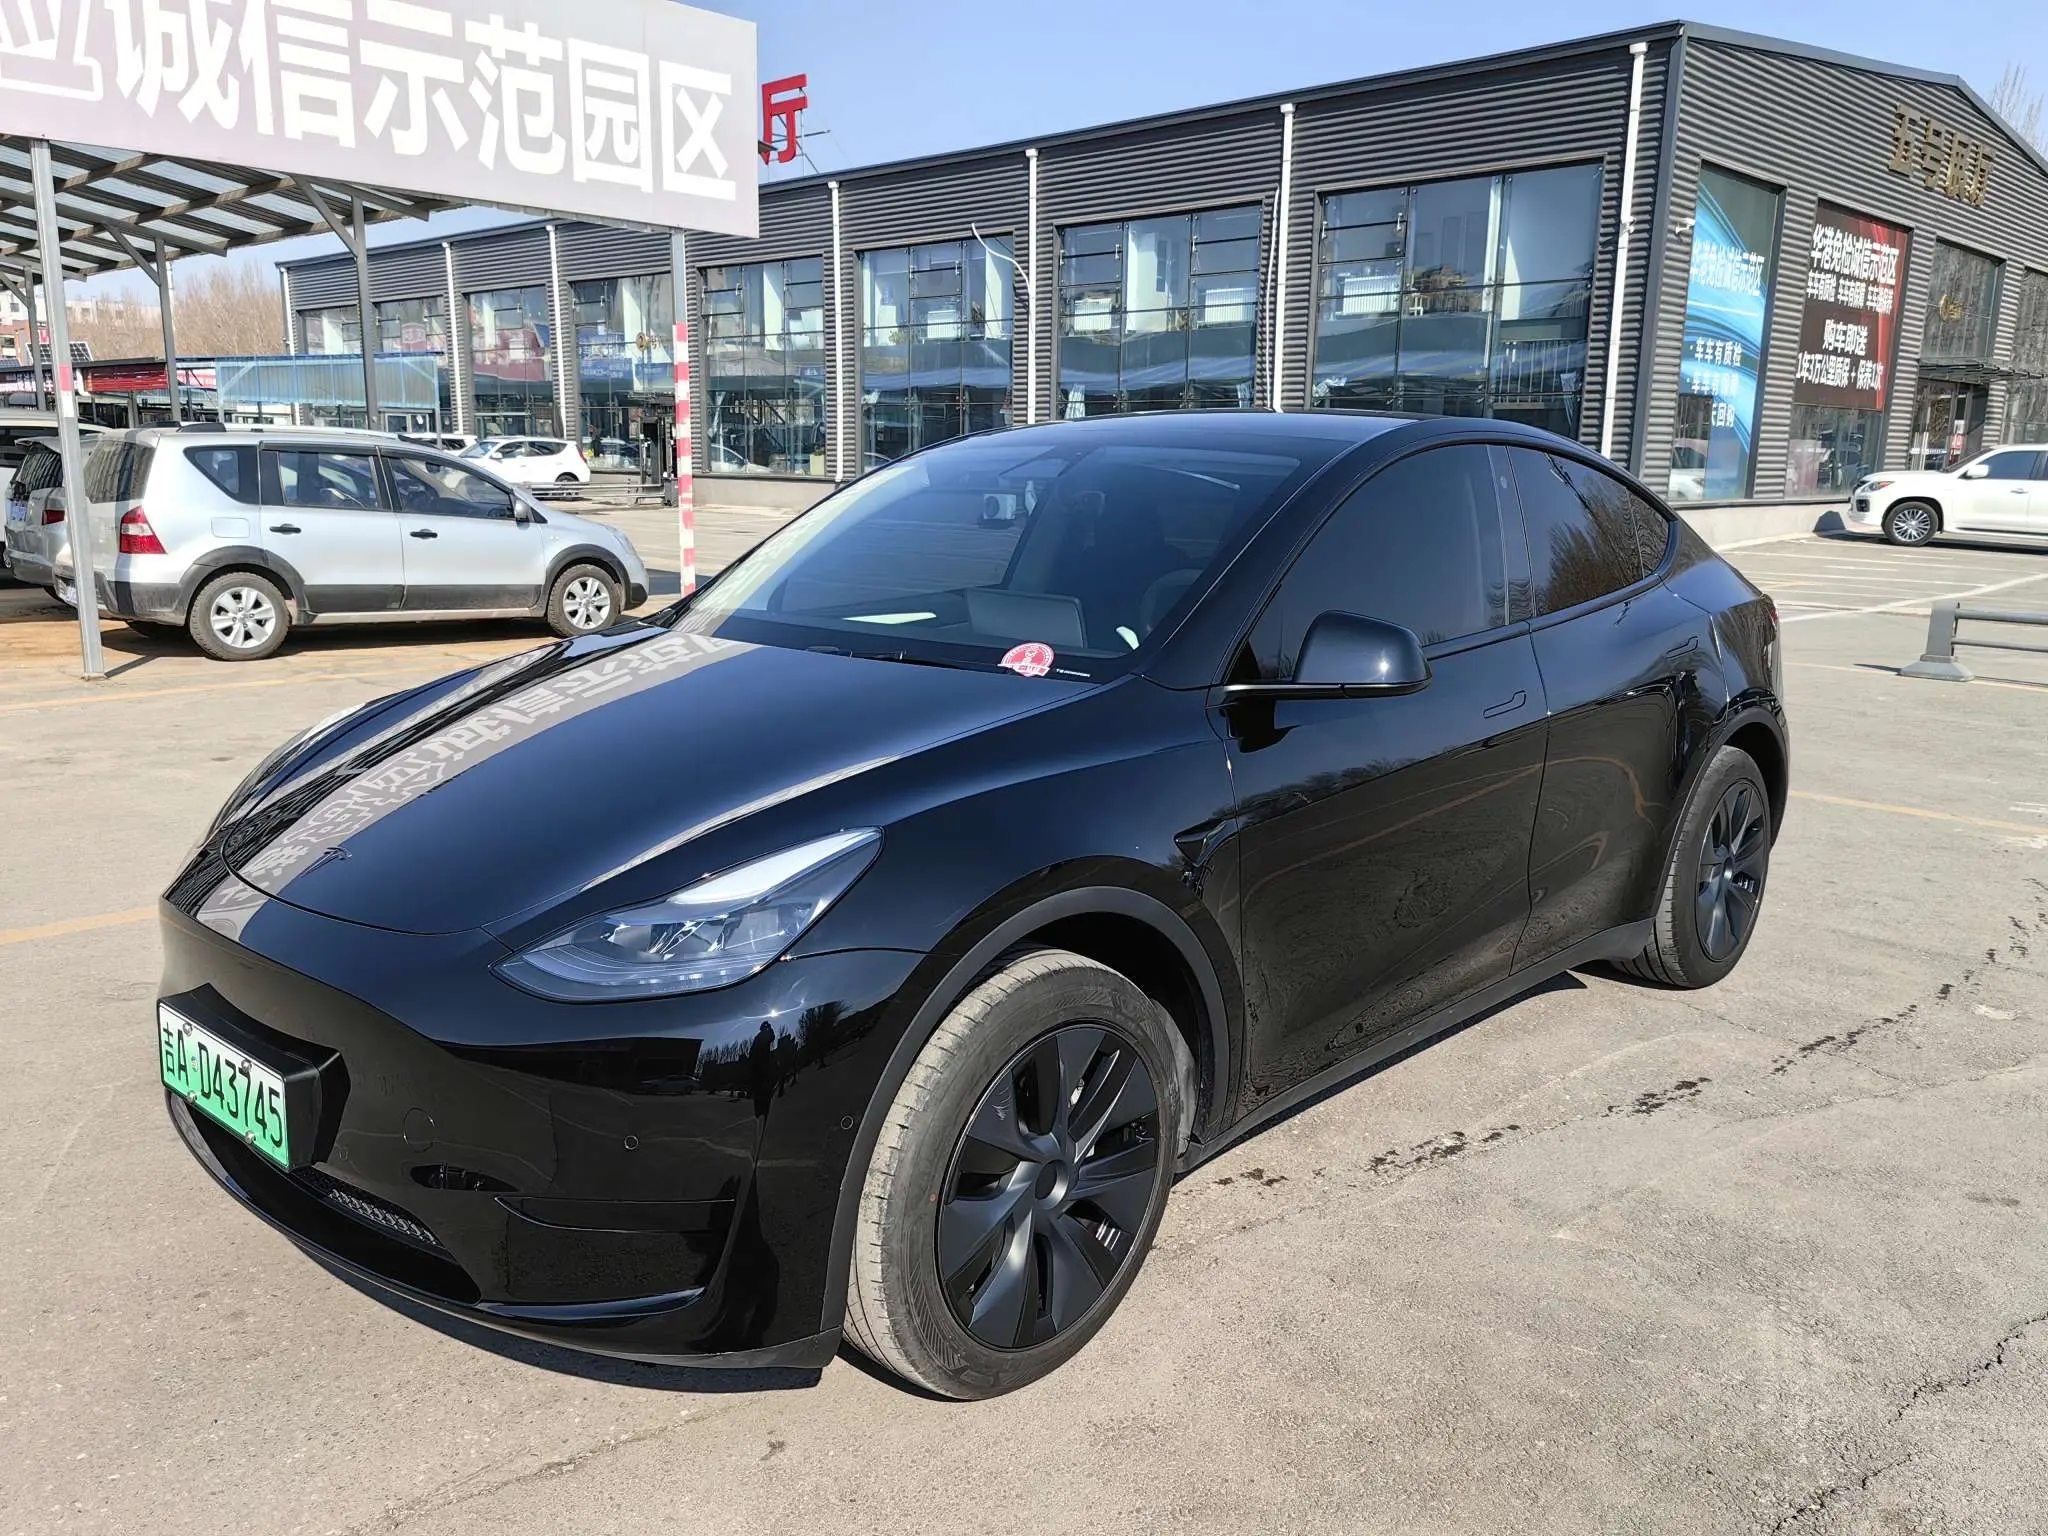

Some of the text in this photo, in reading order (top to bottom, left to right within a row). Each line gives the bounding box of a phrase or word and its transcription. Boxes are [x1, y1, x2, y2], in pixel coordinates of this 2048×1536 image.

[0, 0, 737, 201] 诚信示范园区
[760, 73, 808, 166] 厅
[1888, 103, 1995, 206] 五号展厅
[1810, 223, 1899, 286] 华港免检诚信示范区
[1694, 337, 1743, 367] 车车有质检
[1822, 319, 1868, 356] 购车即送
[1796, 351, 1851, 388] 1年3万公里质保
[1856, 359, 1884, 391] 保养1次
